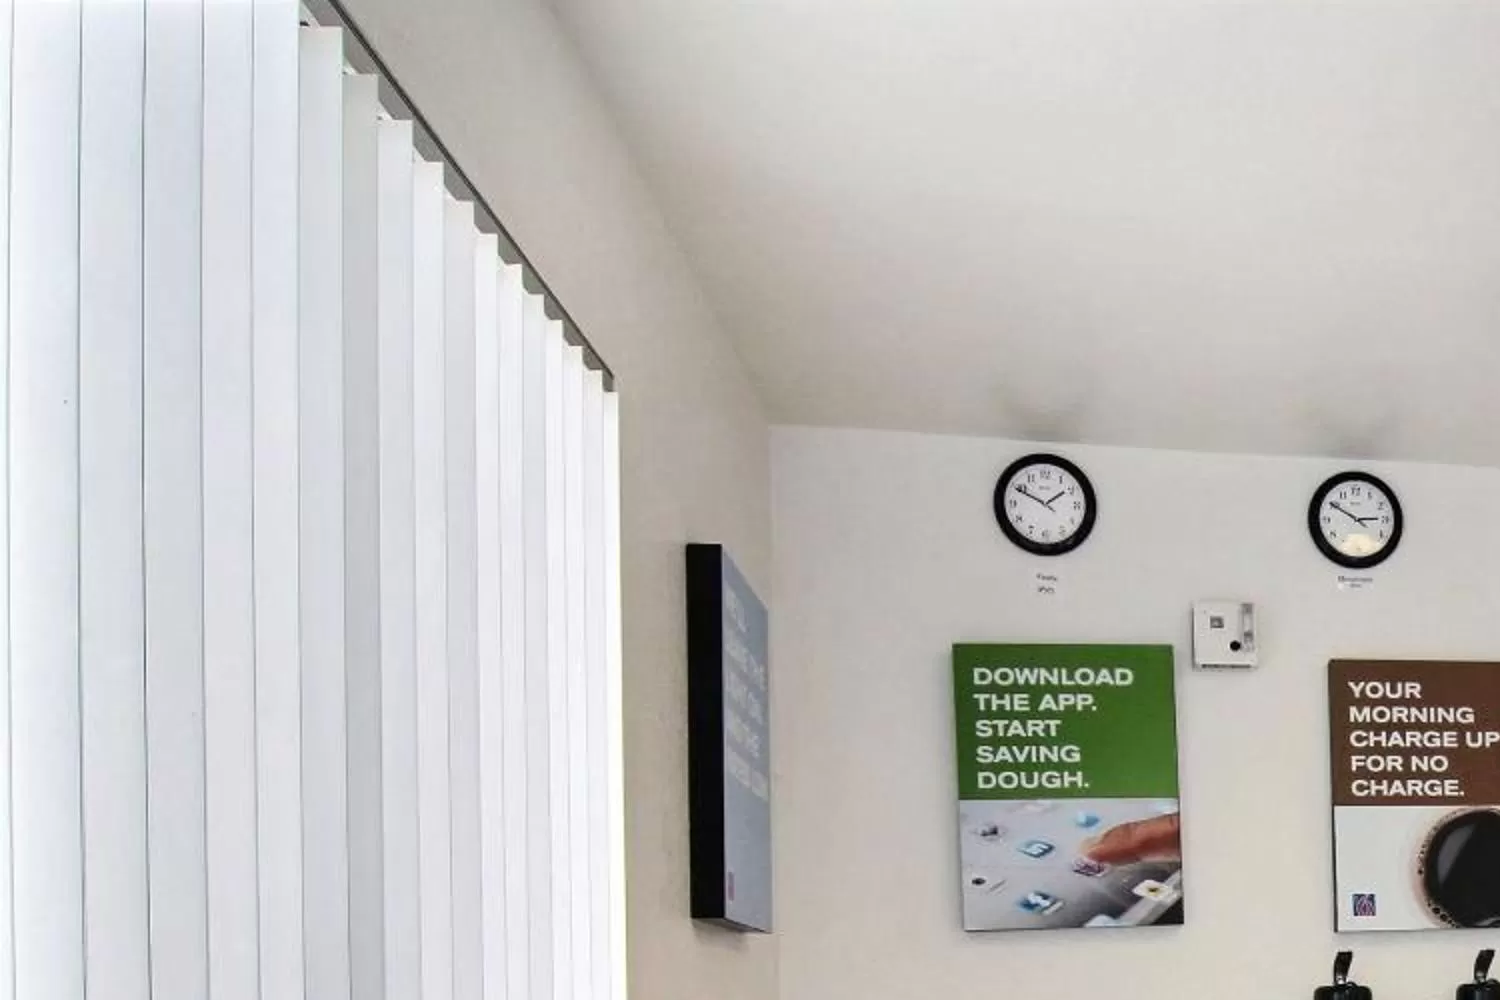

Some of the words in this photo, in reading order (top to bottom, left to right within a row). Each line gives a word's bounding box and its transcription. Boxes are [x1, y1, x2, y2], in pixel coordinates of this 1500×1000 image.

[973, 667, 1134, 686] DOWNLOAD
[1348, 681, 1421, 699] YOUR
[973, 694, 1030, 711] THE
[1038, 694, 1097, 711] APP.
[1349, 706, 1474, 724] MORNING
[976, 720, 1061, 737] START
[1350, 731, 1458, 748] CHARGE
[1466, 731, 1500, 748] UP
[976, 746, 1081, 763] SAVING
[1351, 755, 1403, 772] FOR
[1410, 755, 1448, 772] NO
[977, 771, 1089, 789] DOUGH.
[1351, 779, 1465, 797] CHARGE.
